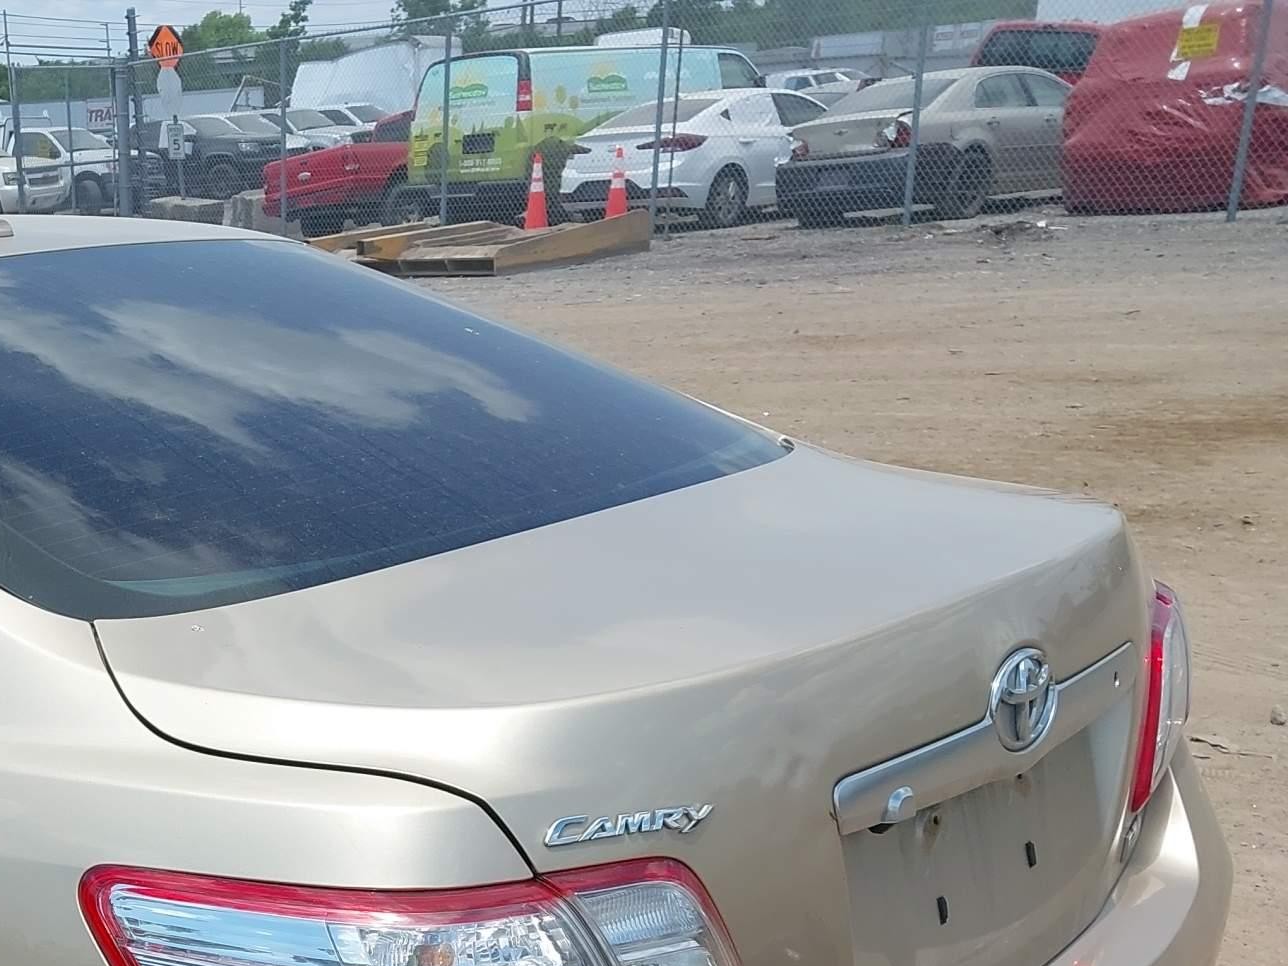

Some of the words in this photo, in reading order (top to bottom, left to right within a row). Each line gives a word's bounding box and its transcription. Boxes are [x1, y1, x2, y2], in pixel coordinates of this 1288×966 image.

[155, 41, 179, 57] SLOW
[173, 138, 181, 151] 5
[544, 803, 714, 848] CAMRY
